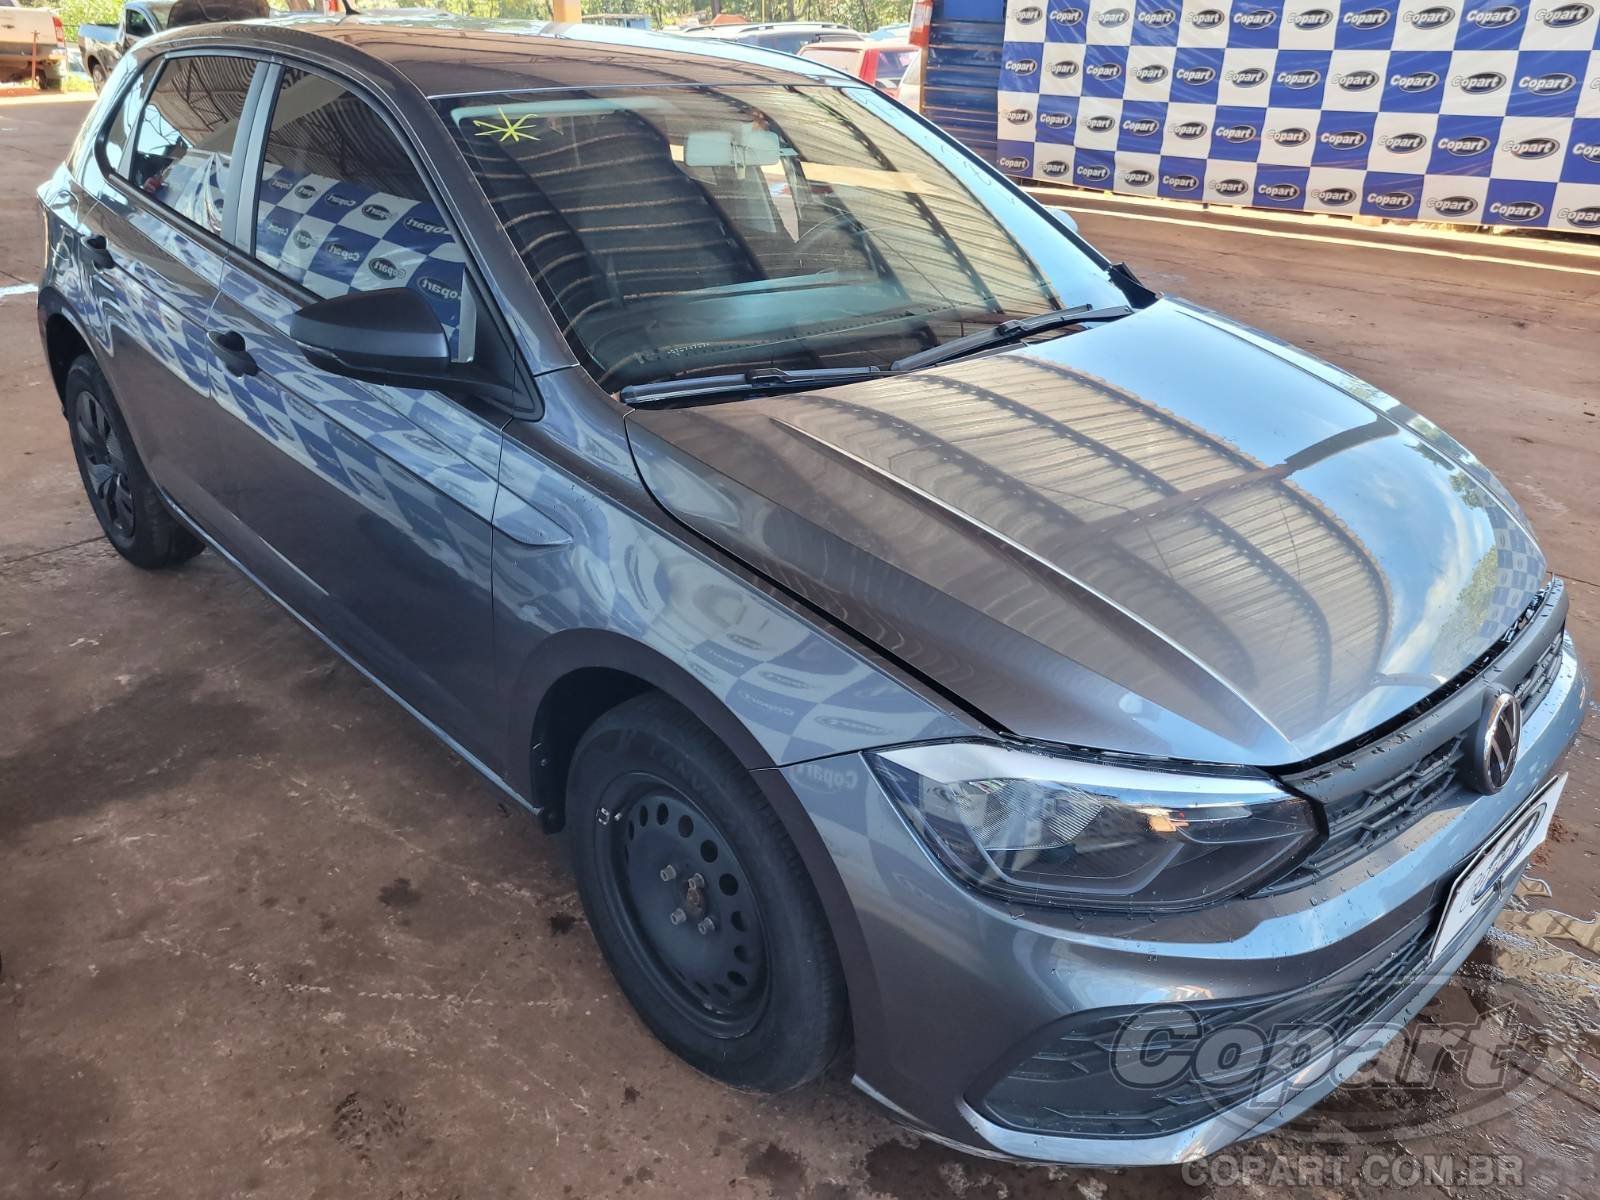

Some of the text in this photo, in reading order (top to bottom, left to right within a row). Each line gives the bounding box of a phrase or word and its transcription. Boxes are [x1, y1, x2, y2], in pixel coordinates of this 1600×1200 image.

[1050, 9, 1079, 21] Copart
[1138, 12, 1173, 25] Copart
[1234, 11, 1274, 26] Copart
[1287, 12, 1326, 26] Copart
[1343, 11, 1387, 26] Copart
[1403, 10, 1448, 25] Copart
[1466, 9, 1513, 25] Copart
[1535, 7, 1586, 22] Copart
[1005, 60, 1034, 73] Copart
[1086, 65, 1118, 77] Copart
[1176, 69, 1213, 82] Copart
[1277, 72, 1316, 85] Copart
[1332, 73, 1375, 87] Copart
[1390, 74, 1436, 89] Copart
[1452, 73, 1500, 90] Copart
[1519, 76, 1569, 91] Copart
[1040, 114, 1068, 126] Copart
[1123, 120, 1156, 135] Copart
[1216, 126, 1254, 141] Copart
[1268, 129, 1304, 142] Copart
[1321, 132, 1364, 147] Copart
[1378, 133, 1422, 150] Copart
[1438, 137, 1487, 153] Copart
[1502, 140, 1553, 157] Copart
[1000, 157, 1026, 169] Copart
[1077, 166, 1106, 178] Copart
[1163, 175, 1197, 189] Copart
[1258, 184, 1295, 198] Copart
[1311, 189, 1349, 202] Copart
[1367, 193, 1411, 208] Copart
[1426, 198, 1474, 213] Copart
[1490, 203, 1541, 219] Copart
[1558, 208, 1600, 223] Copar
